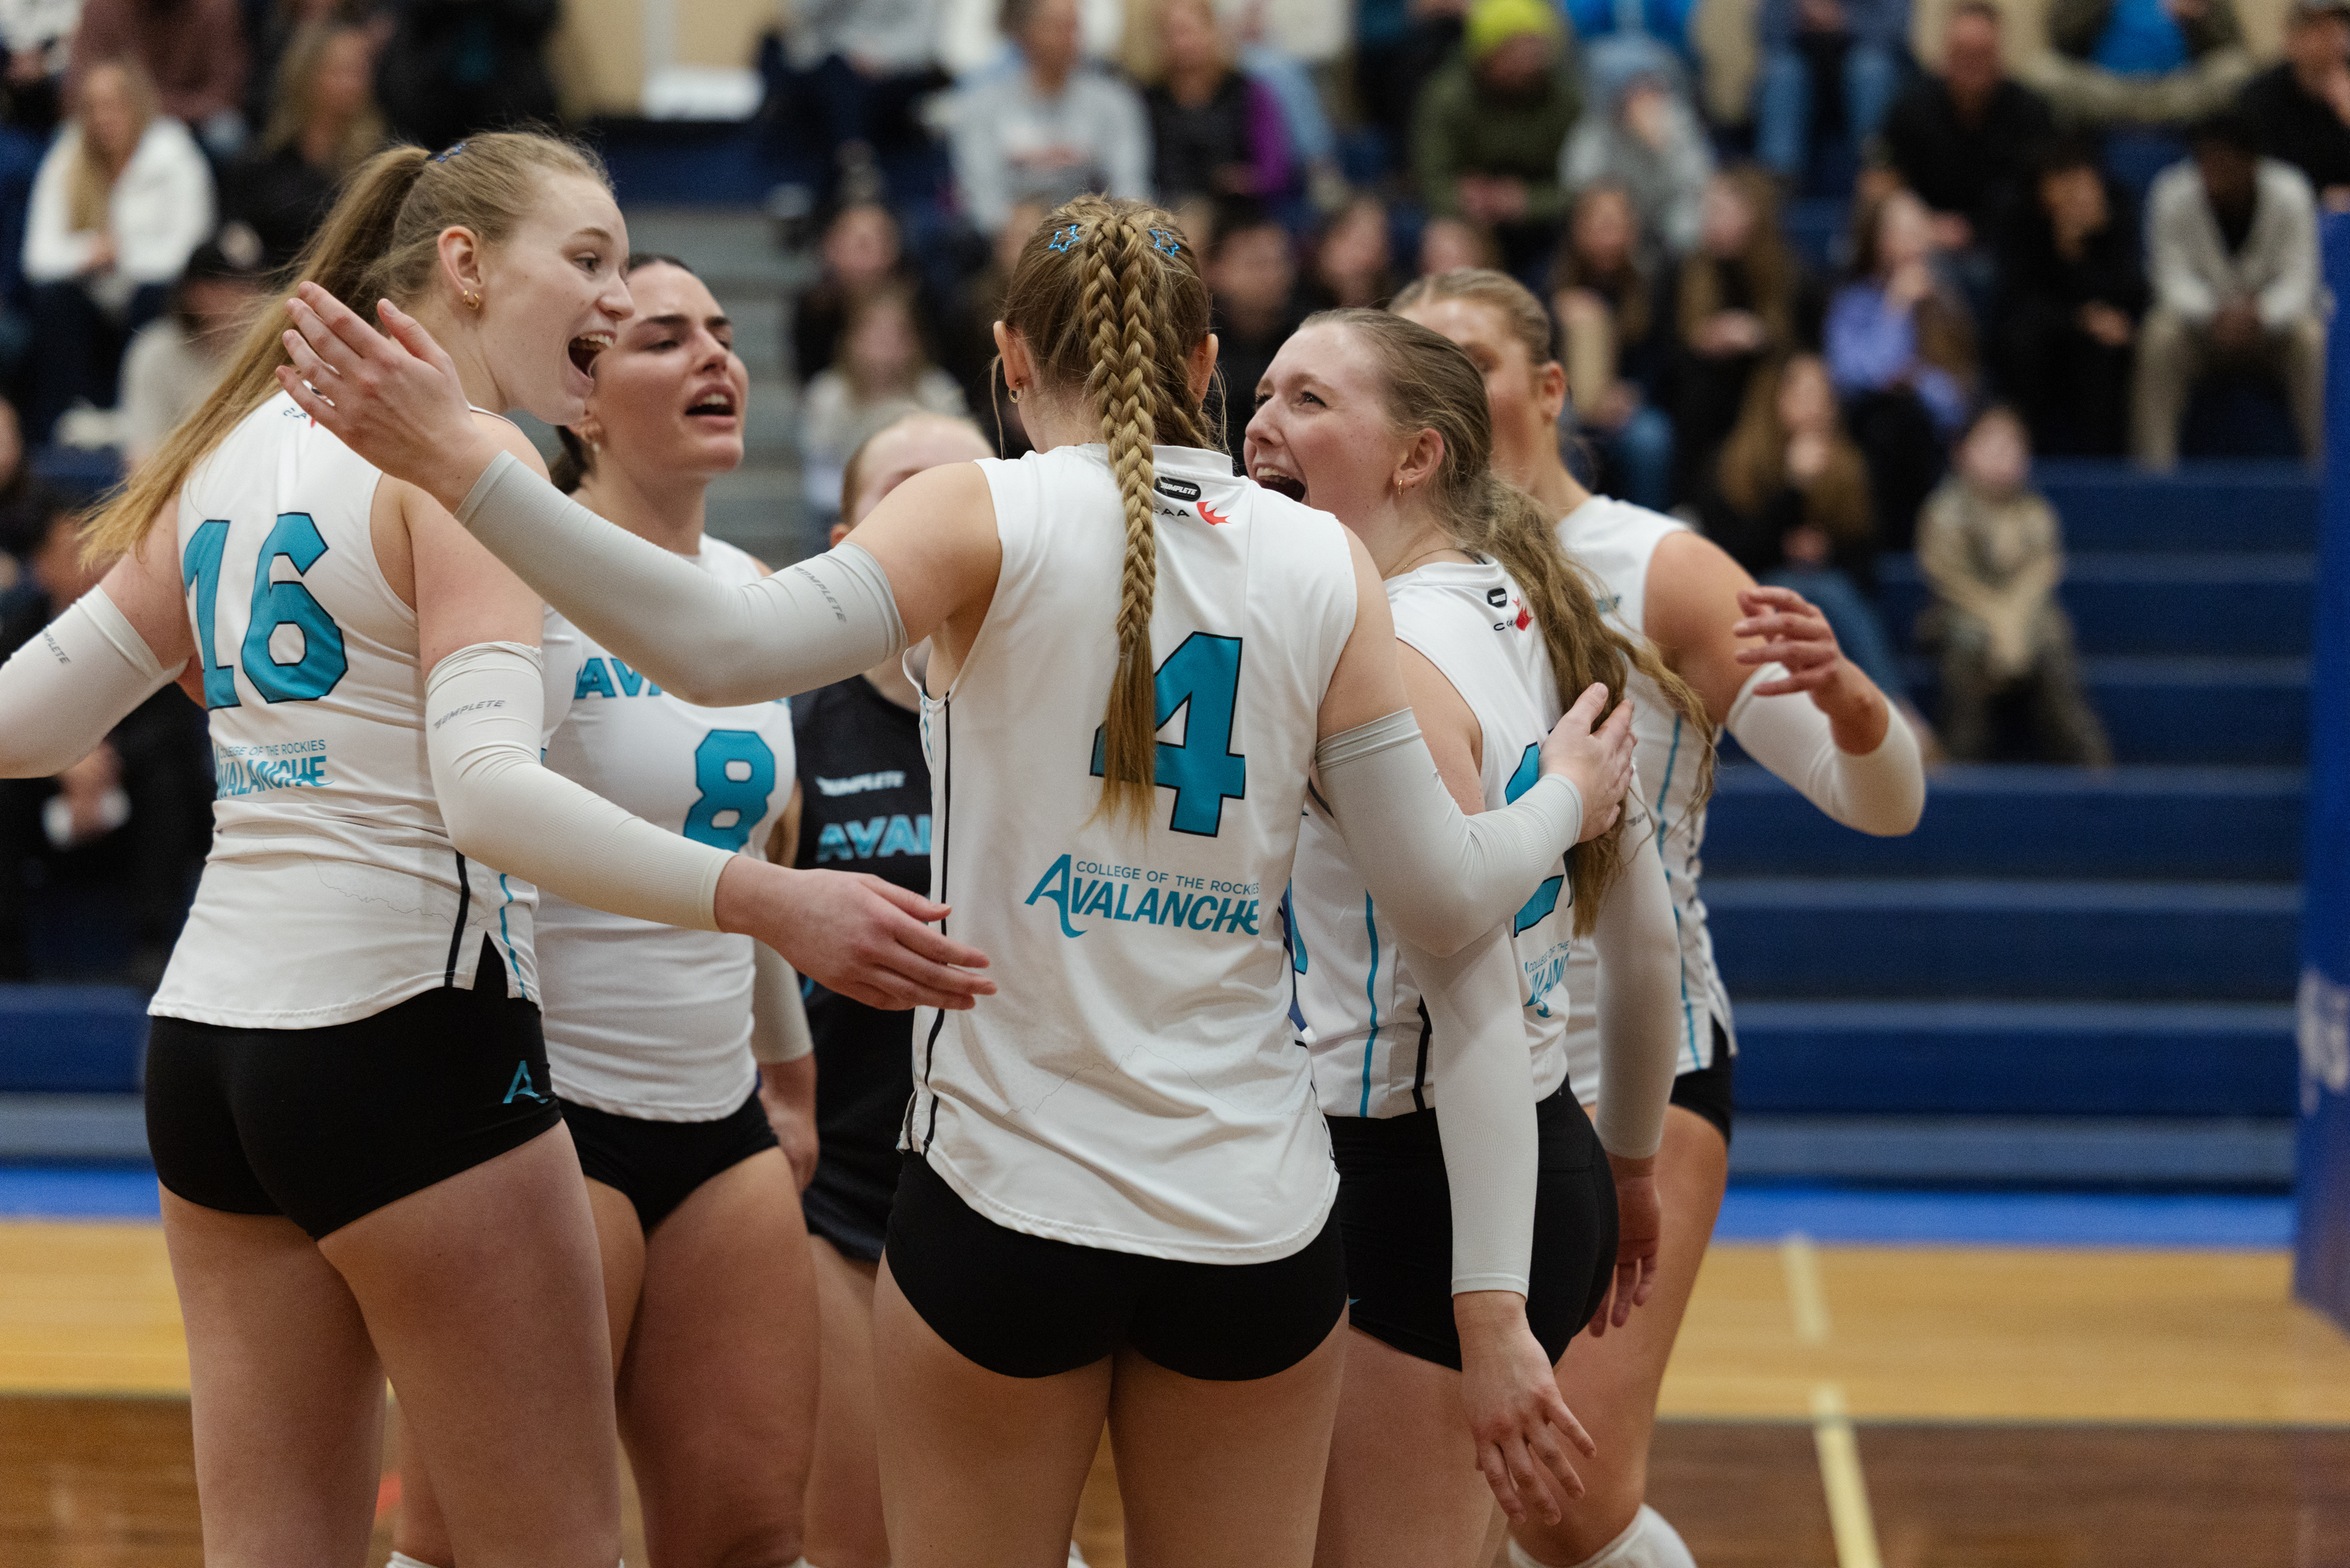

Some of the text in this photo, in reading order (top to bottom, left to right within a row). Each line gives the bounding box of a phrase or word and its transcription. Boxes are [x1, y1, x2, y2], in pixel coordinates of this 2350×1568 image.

[183, 512, 348, 711] 16
[281, 739, 326, 755] ROCKIES
[1089, 631, 1246, 838] 4
[683, 729, 775, 853] 8
[1024, 854, 1259, 938] AVALANCHE
[1076, 860, 1142, 880] COLLEGE
[1146, 871, 1169, 884] OF
[1175, 875, 1205, 890] THE
